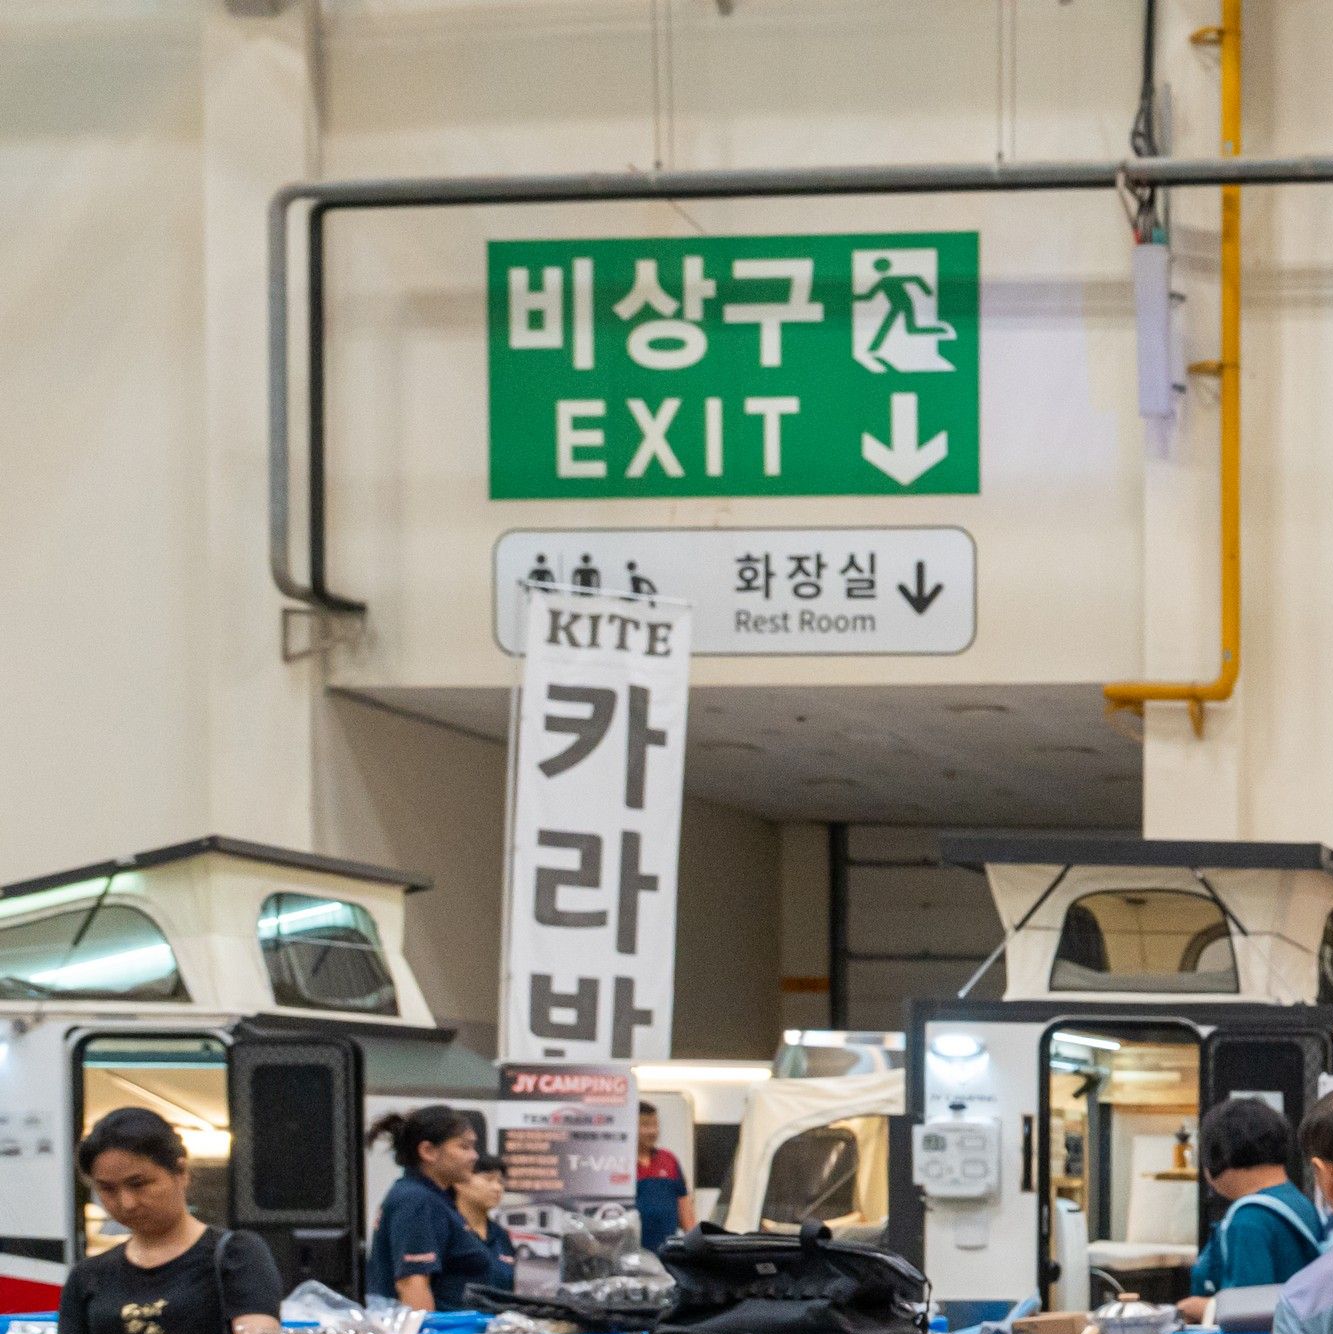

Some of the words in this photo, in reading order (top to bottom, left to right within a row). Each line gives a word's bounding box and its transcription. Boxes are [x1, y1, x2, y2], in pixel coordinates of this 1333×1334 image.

[507, 254, 826, 371] 비상구
[555, 397, 801, 480] EXIT
[733, 551, 879, 602] 화장실
[545, 607, 675, 658] KITE
[733, 609, 792, 635] Rest
[799, 609, 877, 635] Room
